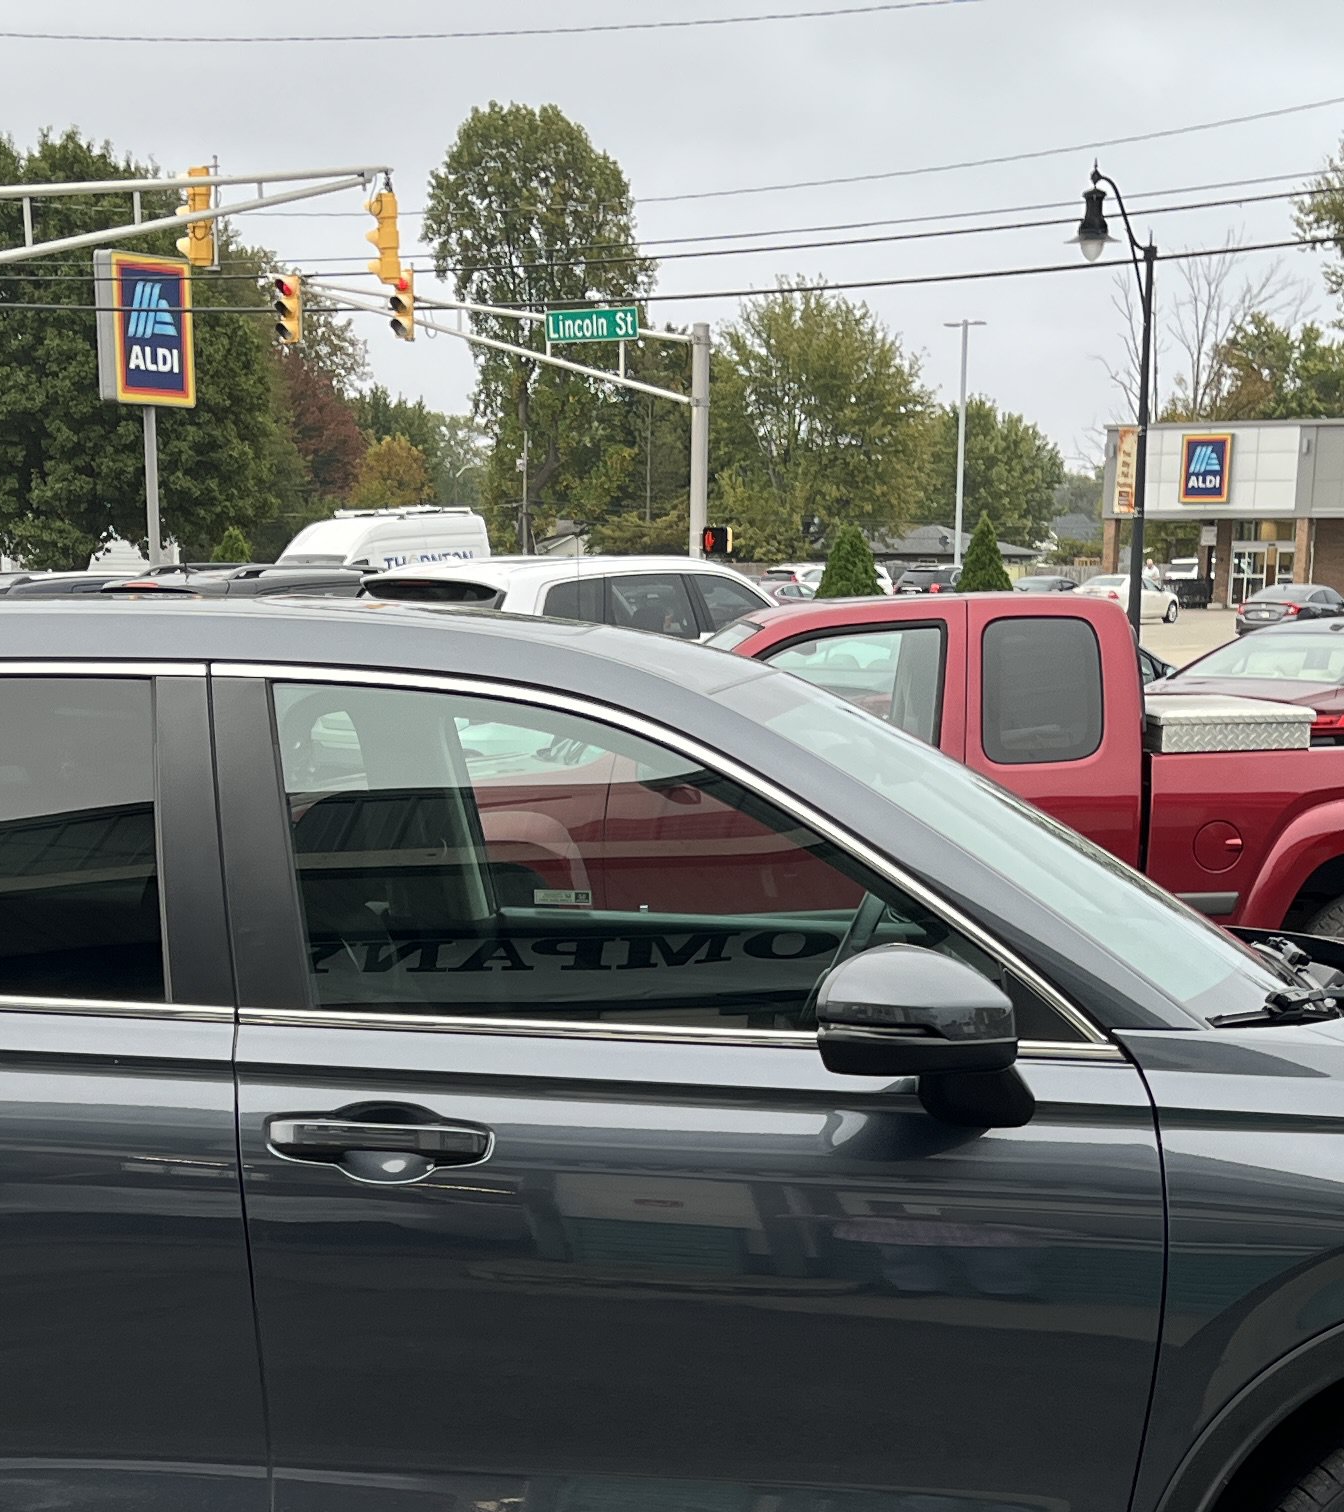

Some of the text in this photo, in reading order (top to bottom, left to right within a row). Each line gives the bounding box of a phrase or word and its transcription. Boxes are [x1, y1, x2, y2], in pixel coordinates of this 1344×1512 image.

[548, 311, 634, 339] Lincoln St
[129, 344, 180, 374] ALDI
[1187, 475, 1221, 489] ALDI
